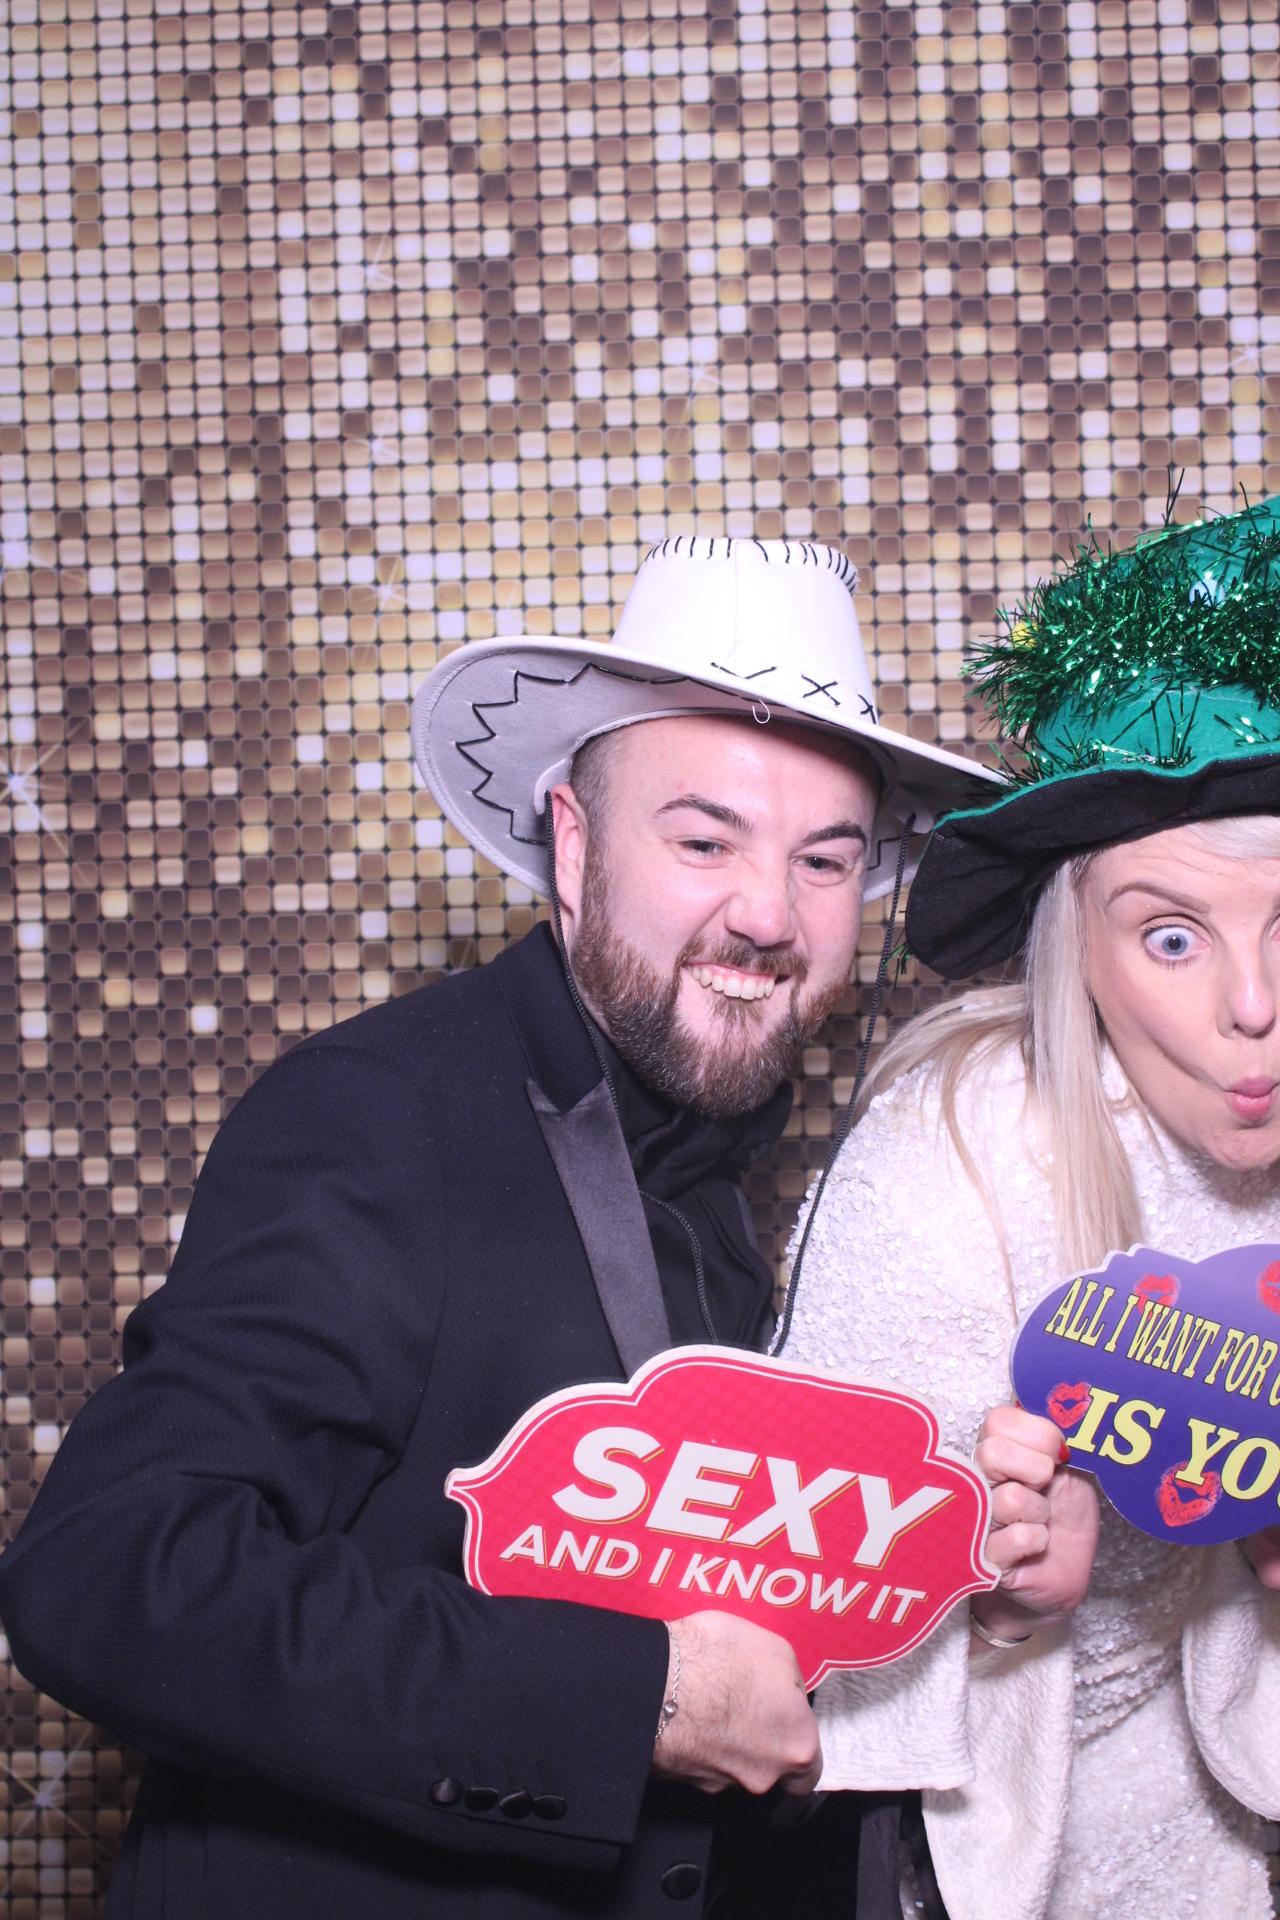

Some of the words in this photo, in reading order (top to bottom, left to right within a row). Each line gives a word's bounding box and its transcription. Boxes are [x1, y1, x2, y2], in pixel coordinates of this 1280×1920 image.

[1045, 1277, 1115, 1346] ALL
[1104, 1294, 1139, 1352] I
[1127, 1301, 1221, 1379] WANT
[1204, 1328, 1278, 1400] FOR
[552, 1427, 957, 1569] SEXY
[1066, 1386, 1166, 1466] IS
[1175, 1417, 1280, 1509] YO
[500, 1526, 641, 1578] AND
[649, 1547, 674, 1585] I
[679, 1554, 868, 1616] KNOW
[868, 1586, 927, 1625] IT
